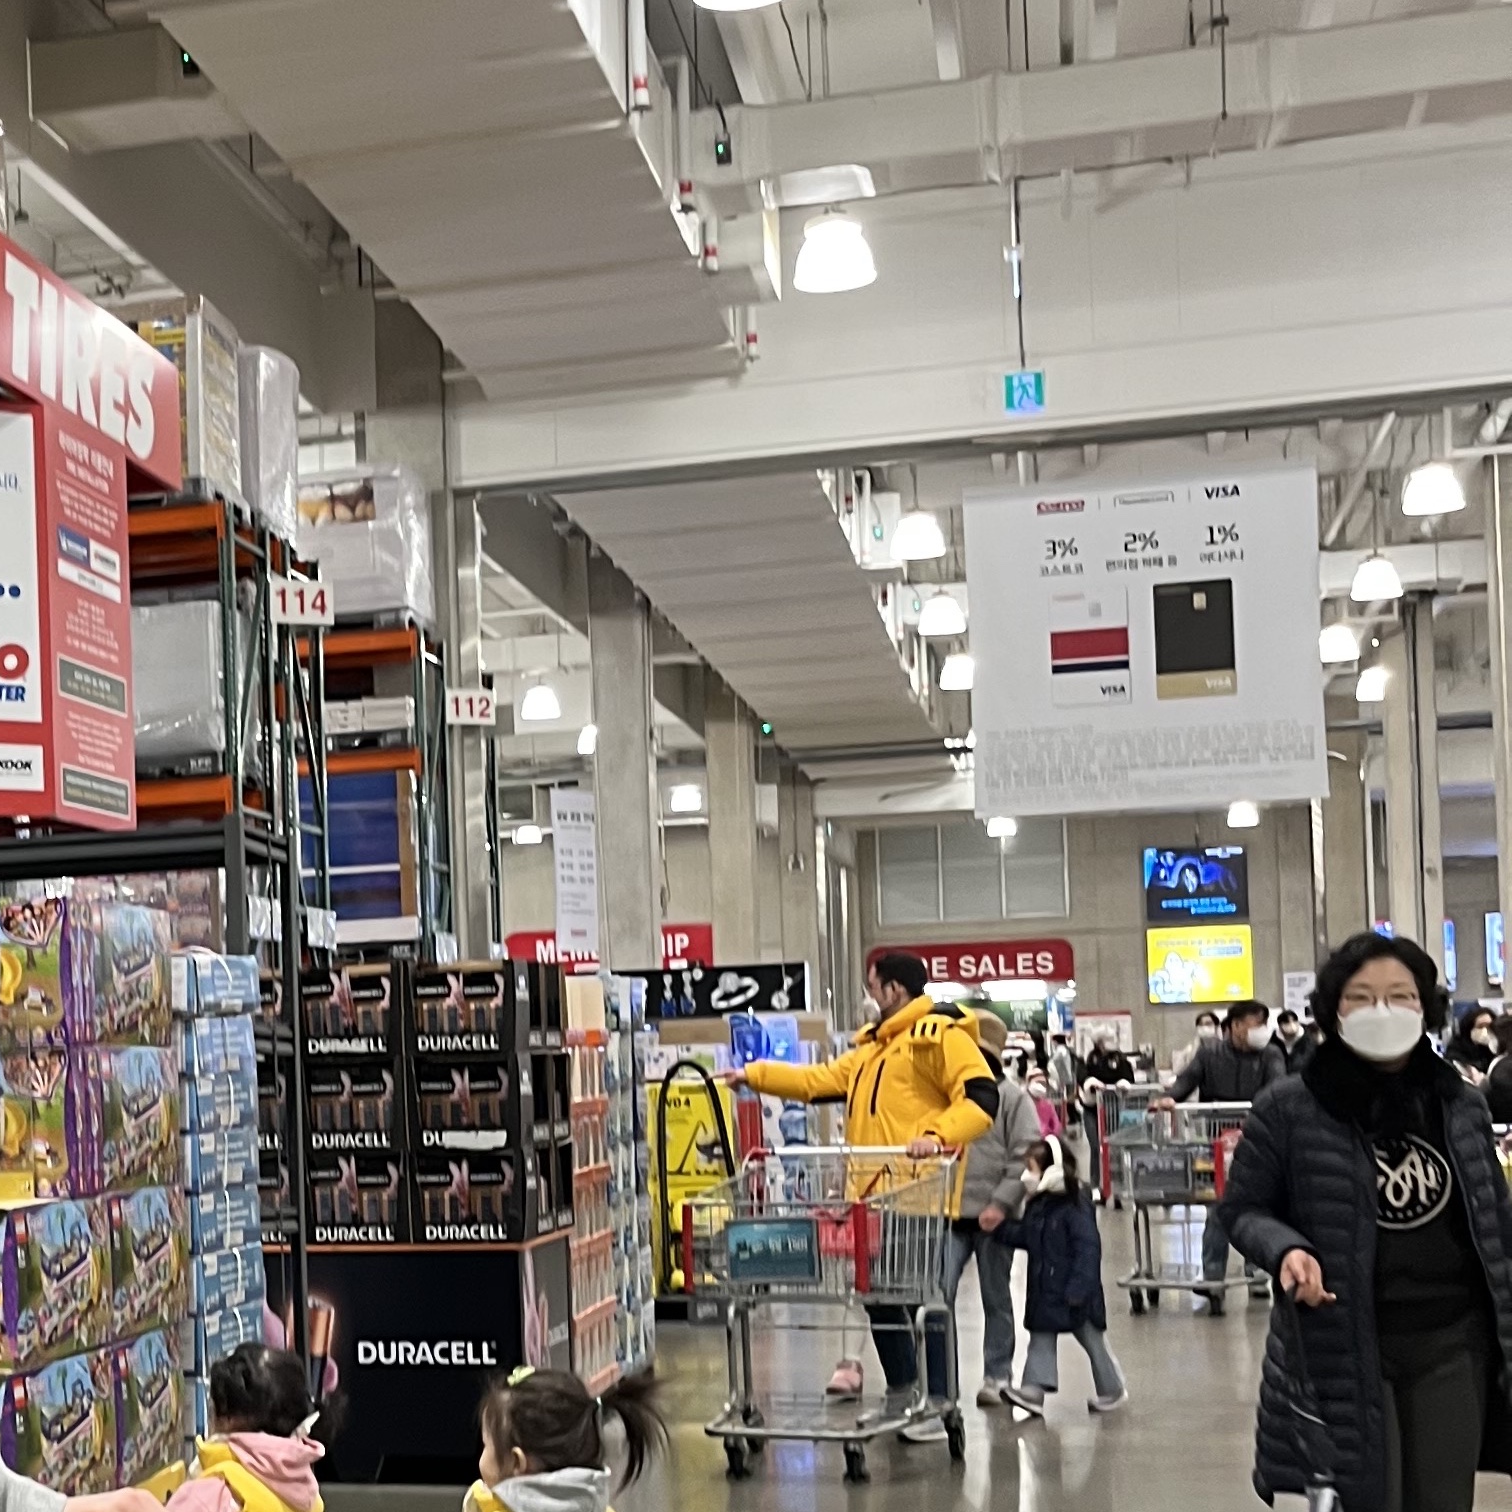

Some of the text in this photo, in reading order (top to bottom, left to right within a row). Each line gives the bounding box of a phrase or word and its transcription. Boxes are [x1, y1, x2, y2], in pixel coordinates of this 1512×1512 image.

[4, 250, 155, 461] TIRES
[1204, 485, 1241, 500] VISA
[1044, 523, 1240, 560] 3% 2% 1%
[276, 587, 328, 616] 114
[451, 696, 491, 718] 112
[959, 951, 1055, 978] SALES
[418, 1034, 499, 1051] DURACELL
[312, 1131, 390, 1149] DURACELL
[315, 1225, 395, 1243] DURACELL
[426, 1224, 507, 1241] DURACELL
[358, 1340, 496, 1365] DURACELL
